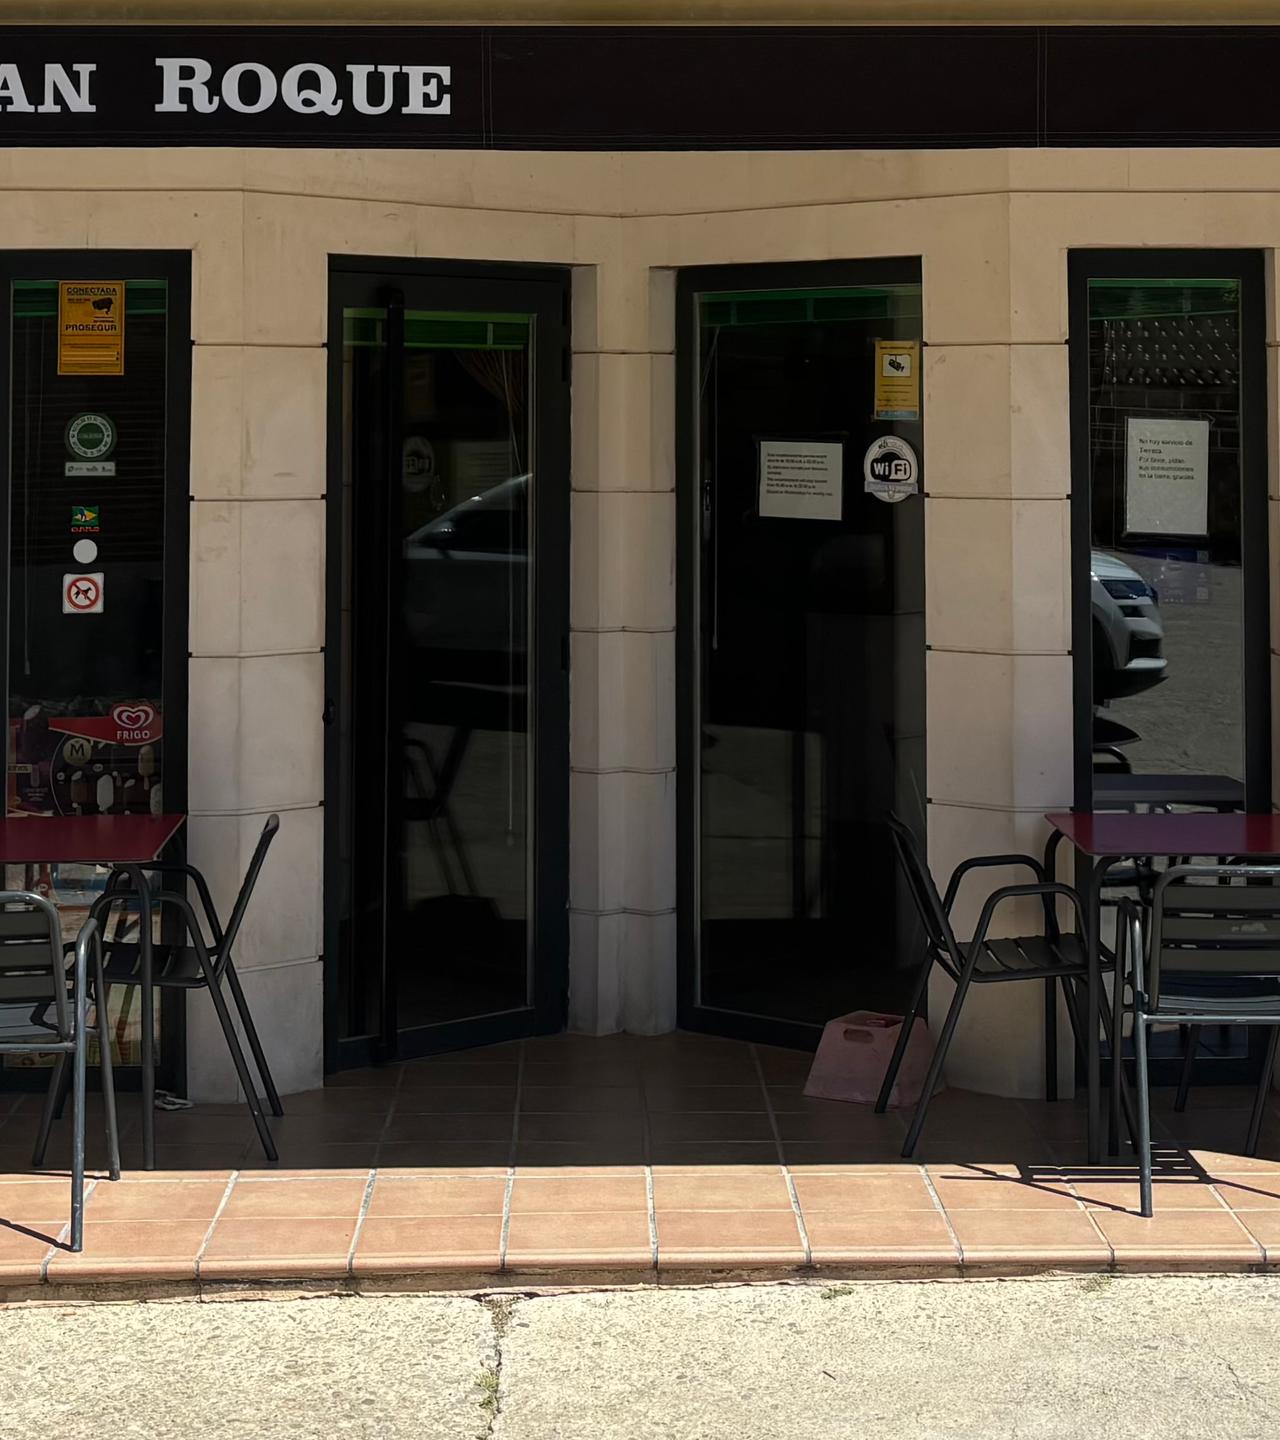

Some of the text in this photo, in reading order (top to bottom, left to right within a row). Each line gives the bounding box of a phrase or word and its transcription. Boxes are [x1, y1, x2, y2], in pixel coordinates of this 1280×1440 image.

[154, 57, 451, 116] ROQUE
[65, 324, 117, 332] PROSEGUR
[116, 730, 151, 740] FRIGO
[70, 743, 85, 757] M
